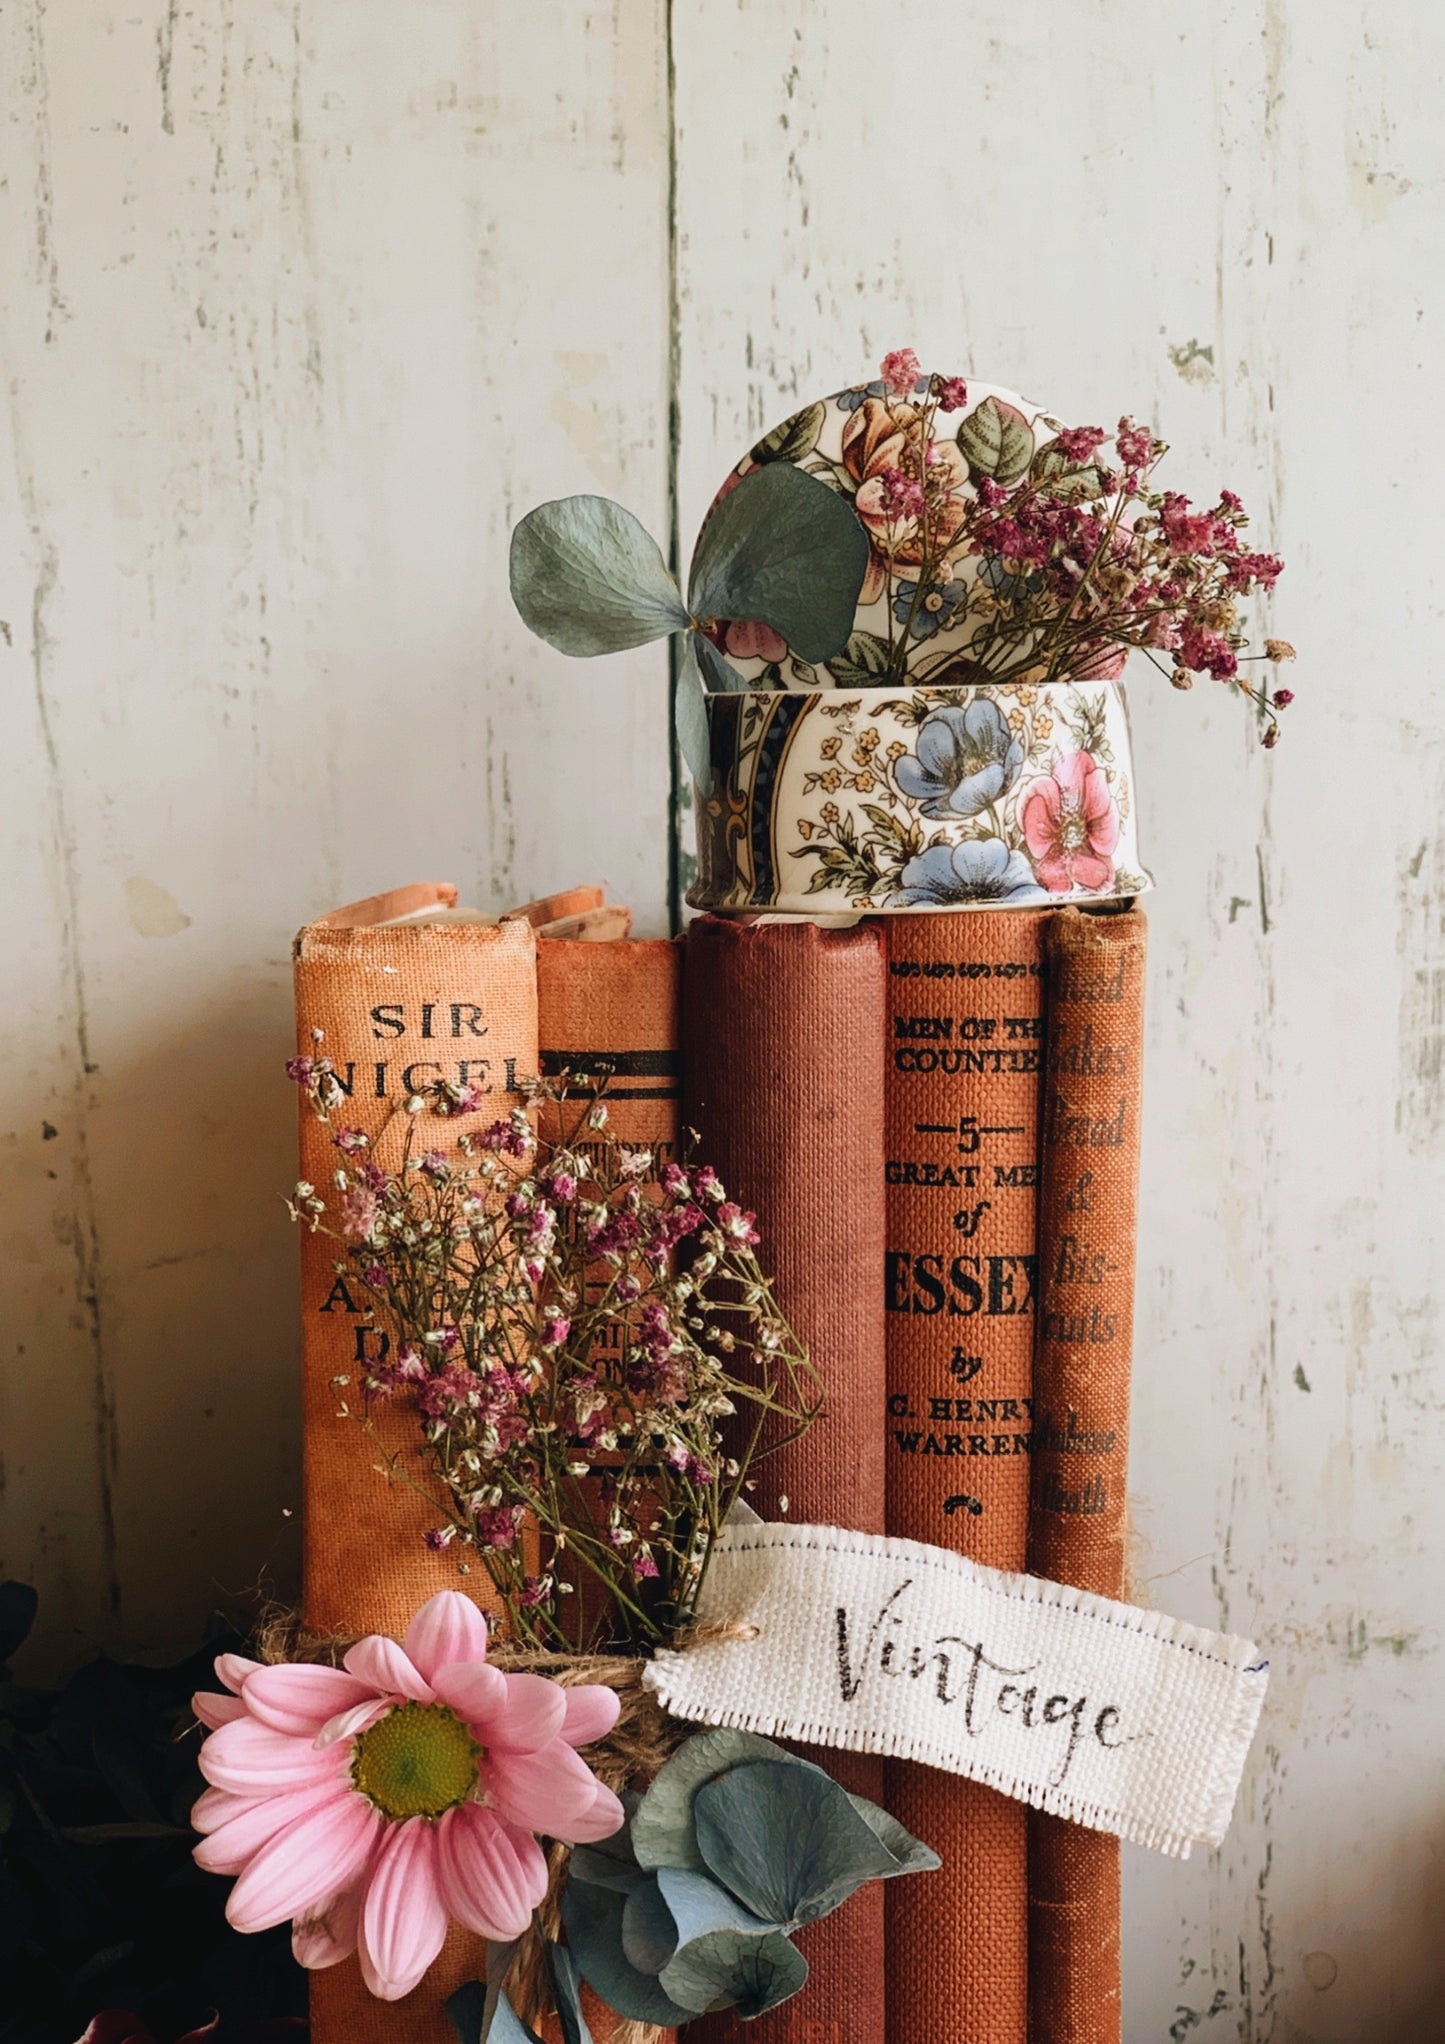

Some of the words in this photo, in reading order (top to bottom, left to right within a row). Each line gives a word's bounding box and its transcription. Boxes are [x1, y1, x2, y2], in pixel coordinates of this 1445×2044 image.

[371, 1003, 489, 1039] SIR
[894, 1016, 953, 1039] MEN
[959, 1017, 997, 1040] OF
[1002, 1017, 1042, 1040] TH
[894, 1047, 1041, 1074] COUNTIE
[318, 1057, 522, 1098] NIGEL
[885, 1161, 980, 1188] GREAT
[993, 1164, 1041, 1188] ME
[953, 1200, 992, 1238] of
[950, 1347, 982, 1383] by
[887, 1394, 916, 1418] G.
[894, 1431, 1036, 1456] WARREN
[836, 1579, 1148, 1787] Vintage
